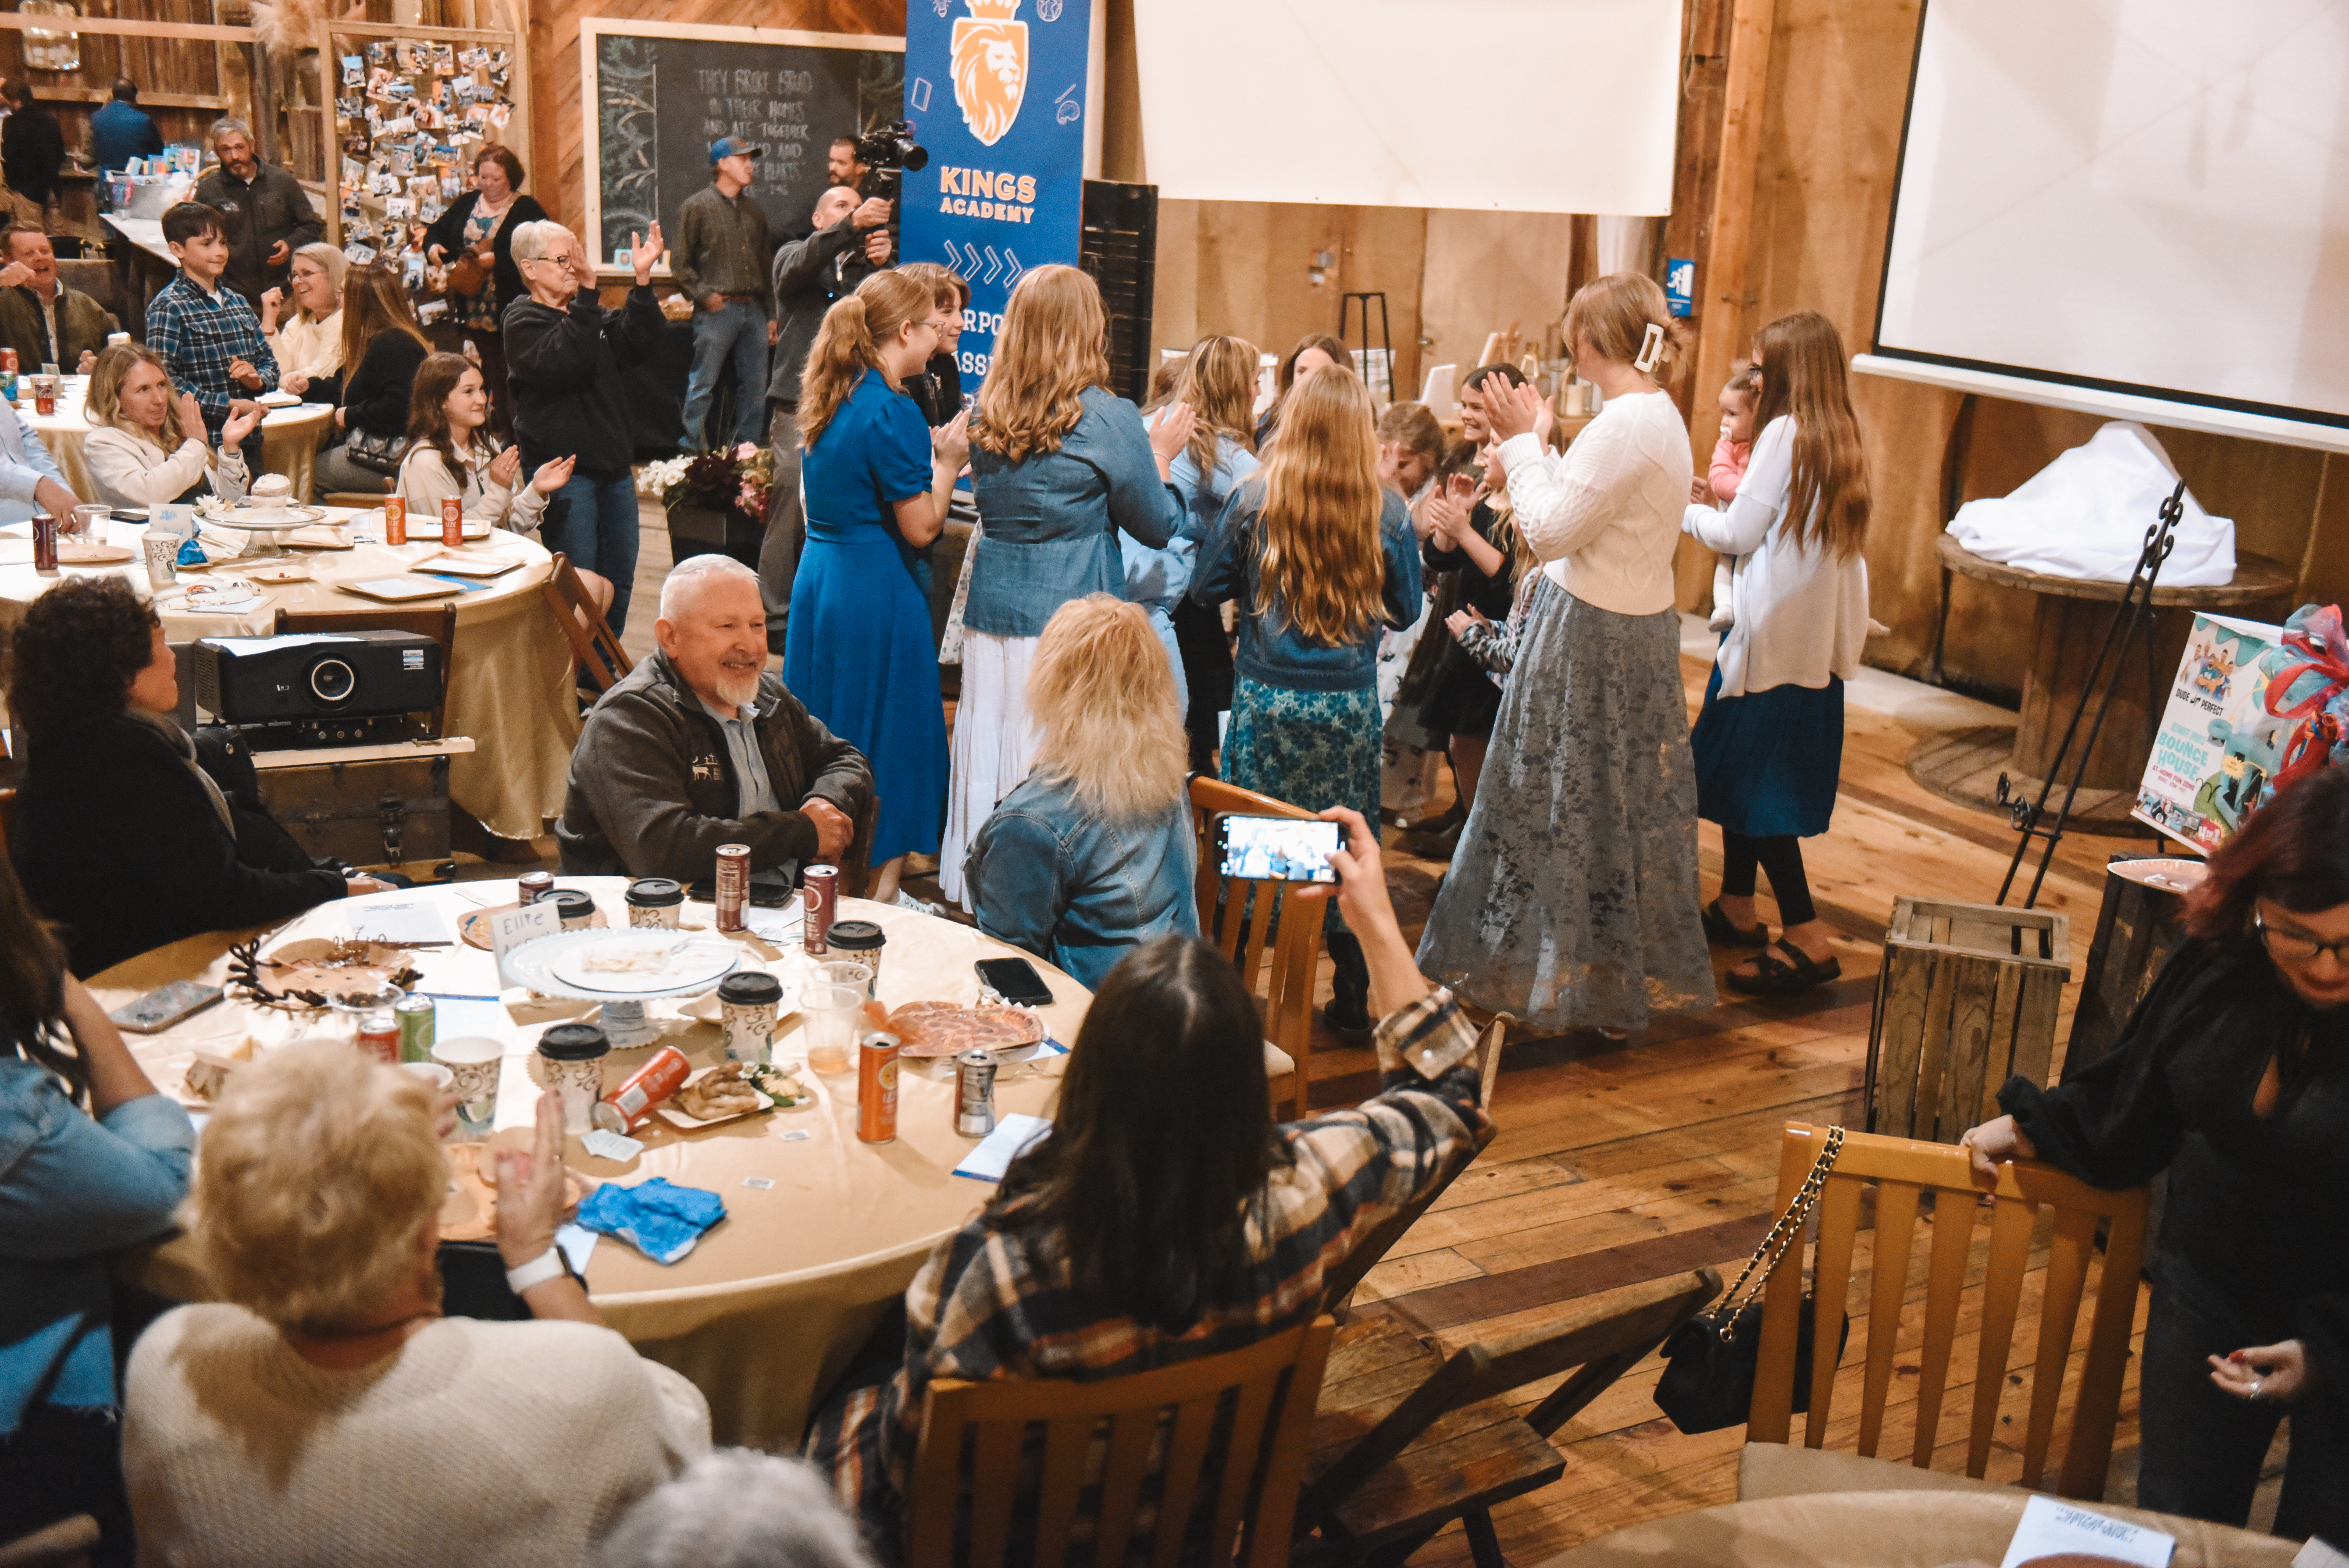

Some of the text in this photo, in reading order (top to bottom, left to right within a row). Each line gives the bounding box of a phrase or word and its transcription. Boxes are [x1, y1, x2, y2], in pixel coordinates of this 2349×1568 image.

[940, 166, 1036, 203] KINGS
[939, 197, 1035, 224] ACADEMY
[2175, 688, 2190, 702] DUDE
[2200, 699, 2224, 716] PERFECT
[2158, 731, 2209, 766] BOUNCE
[2152, 764, 2173, 779] AT-HOME
[2173, 775, 2182, 784] FUN
[2182, 780, 2195, 791] ZONE
[2158, 749, 2200, 781] HOUSE
